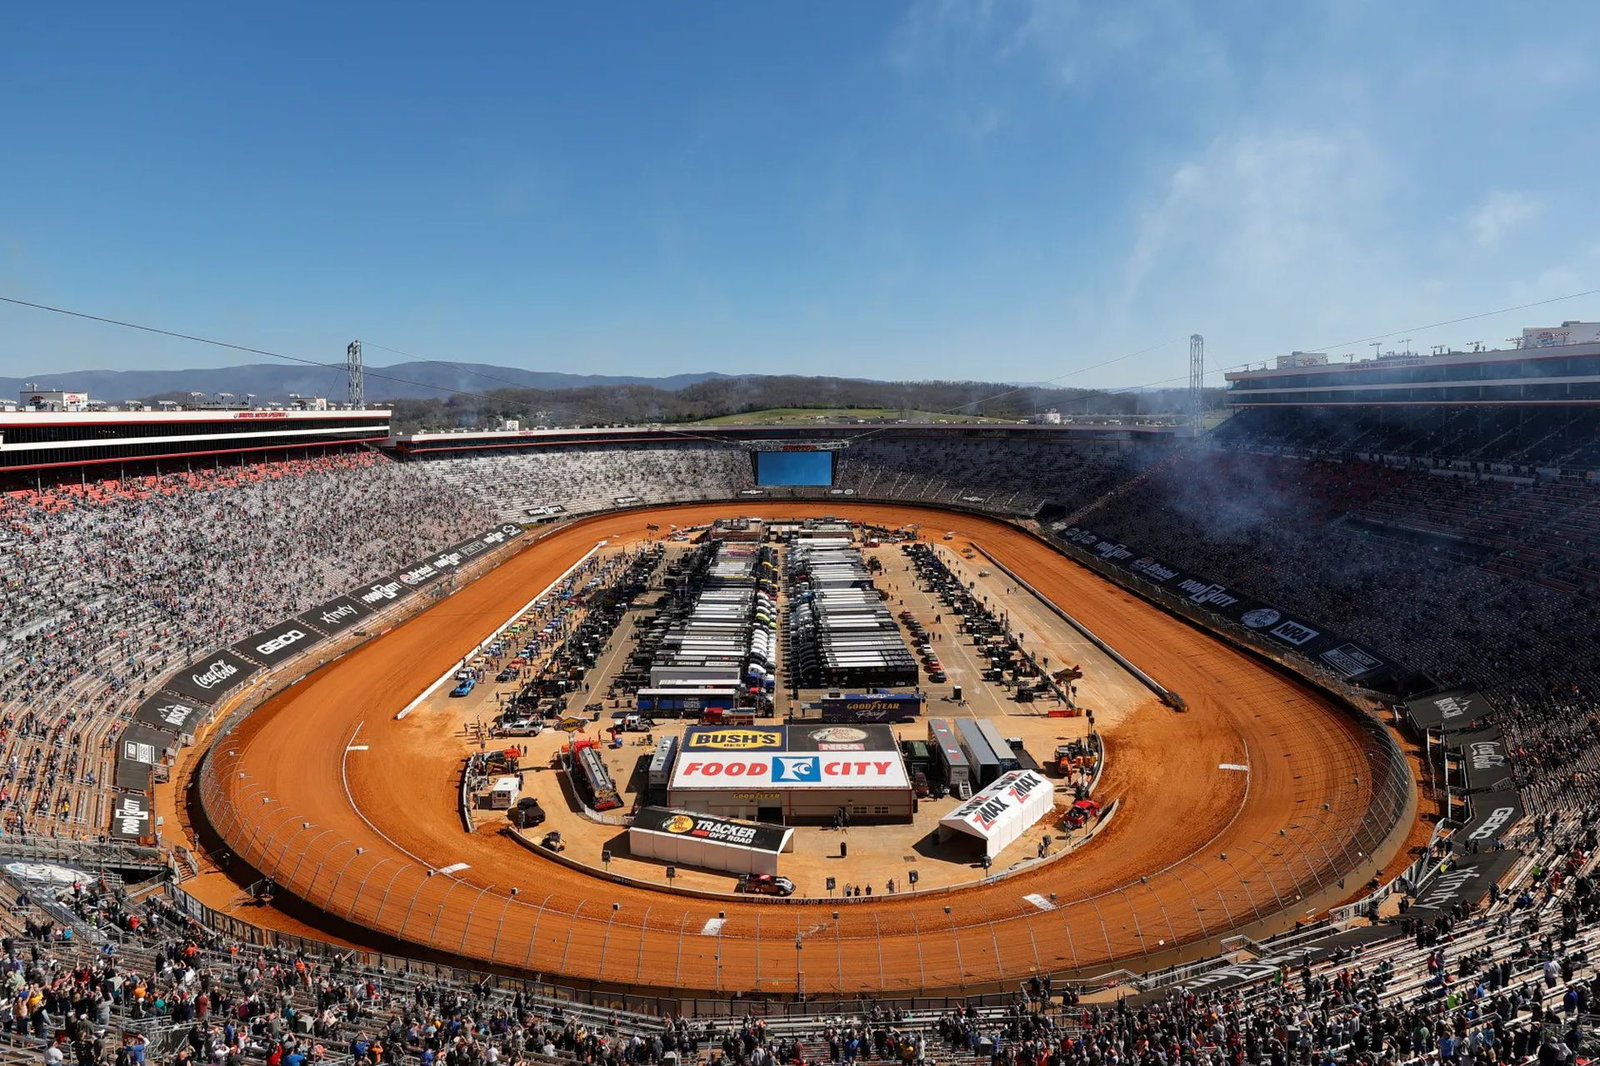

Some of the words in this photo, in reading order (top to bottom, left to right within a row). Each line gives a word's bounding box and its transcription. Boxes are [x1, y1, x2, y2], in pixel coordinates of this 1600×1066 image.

[1177, 579, 1207, 594] FOOD
[1208, 593, 1239, 608] CITY
[320, 604, 358, 624] xfinity
[256, 629, 305, 655] GEICO
[1276, 623, 1310, 642] NRA
[846, 702, 900, 711] GOODYEAR
[696, 734, 776, 745] BUSH'S
[683, 763, 769, 776] FOOD
[824, 762, 892, 776] CITY
[696, 819, 757, 839] TRACKER
[1469, 807, 1514, 839] GEICO
[709, 832, 727, 840] OFF
[727, 835, 752, 844] ROAD
[753, 897, 787, 905] BRISTOL
